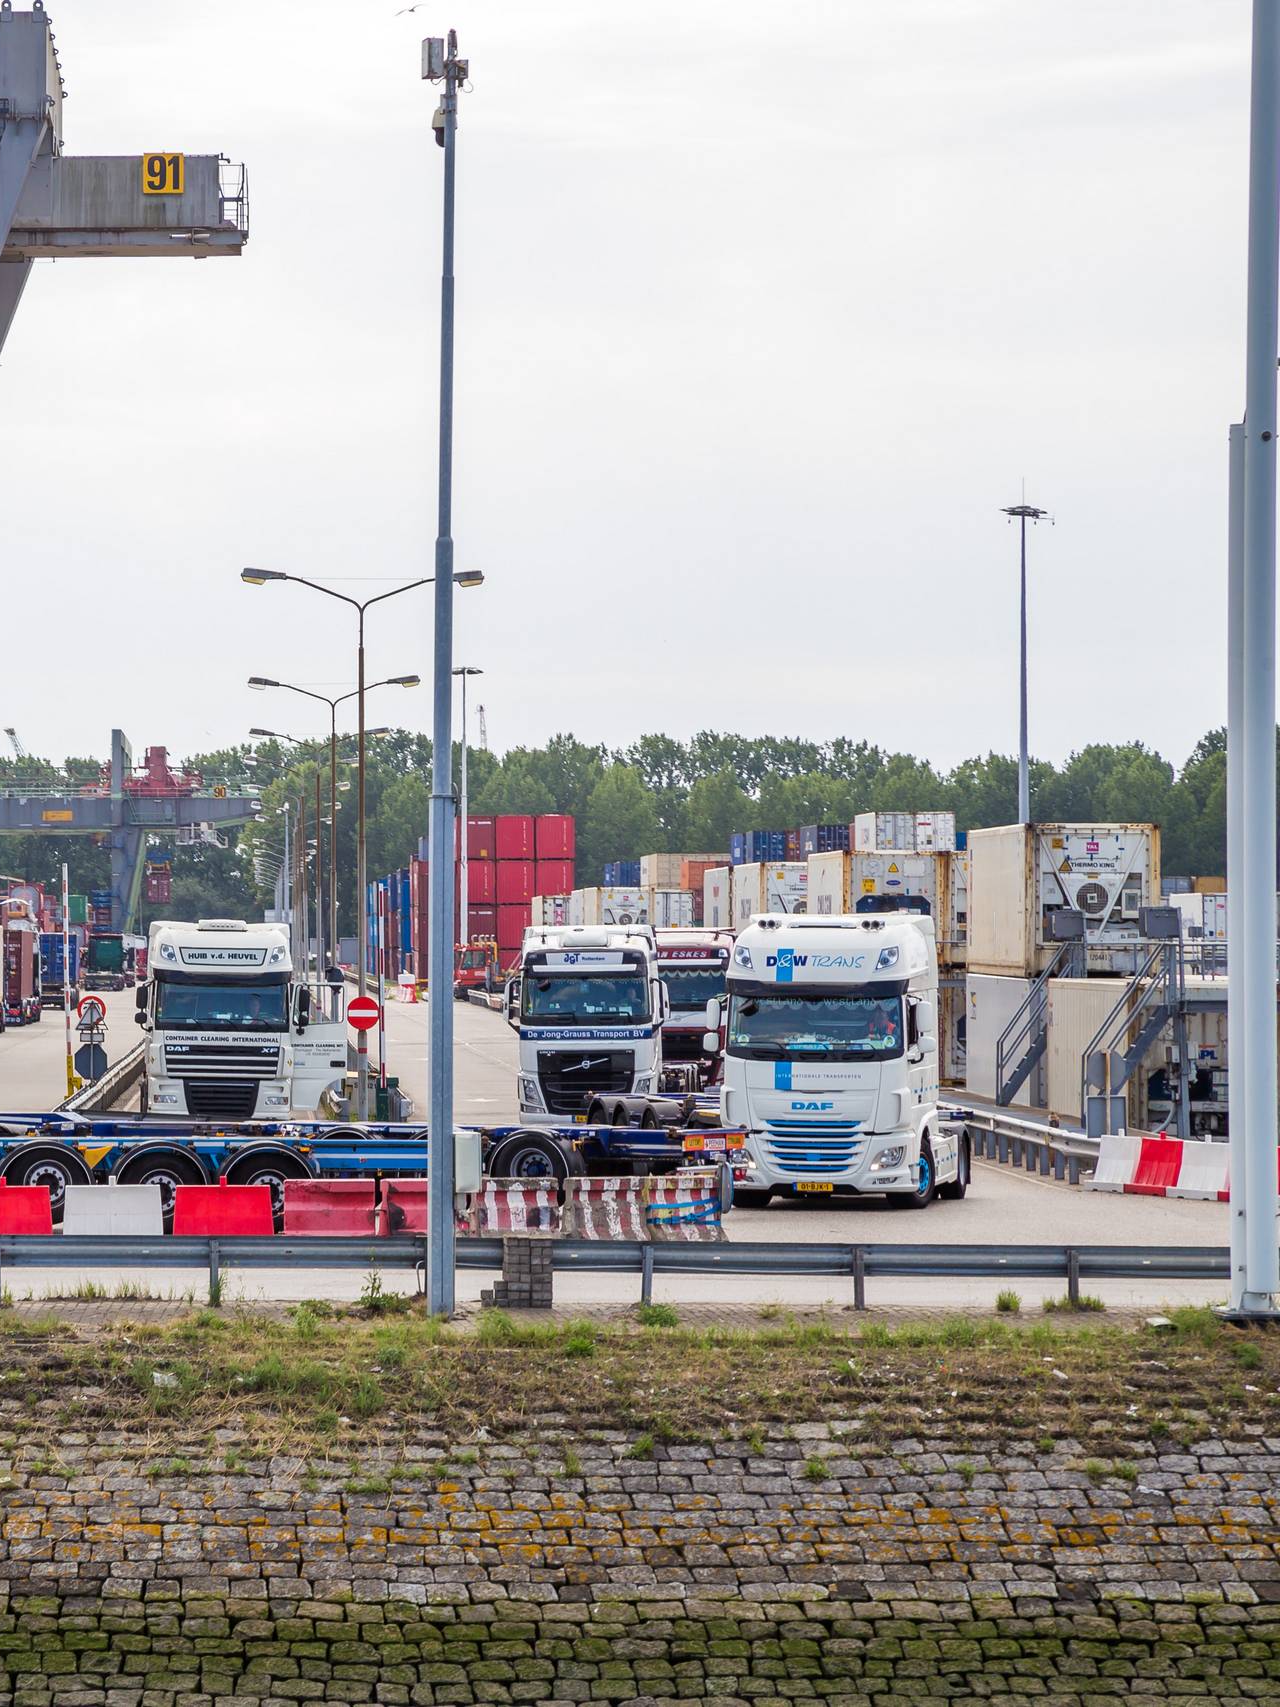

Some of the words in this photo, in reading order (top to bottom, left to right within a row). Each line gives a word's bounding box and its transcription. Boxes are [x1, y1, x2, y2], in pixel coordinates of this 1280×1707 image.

[147, 155, 180, 190] 91
[187, 952, 208, 960] HUIB
[210, 952, 225, 960] v.d.
[227, 953, 258, 961] HEUVEL
[672, 950, 707, 959] ESKES
[766, 954, 808, 968] D&W
[810, 955, 865, 969] TRANS
[527, 1030, 538, 1038] De
[541, 1030, 591, 1041] Jong-Grauss
[592, 1029, 630, 1040] Transport
[632, 1029, 645, 1038] BV
[791, 1101, 834, 1110] DAF
